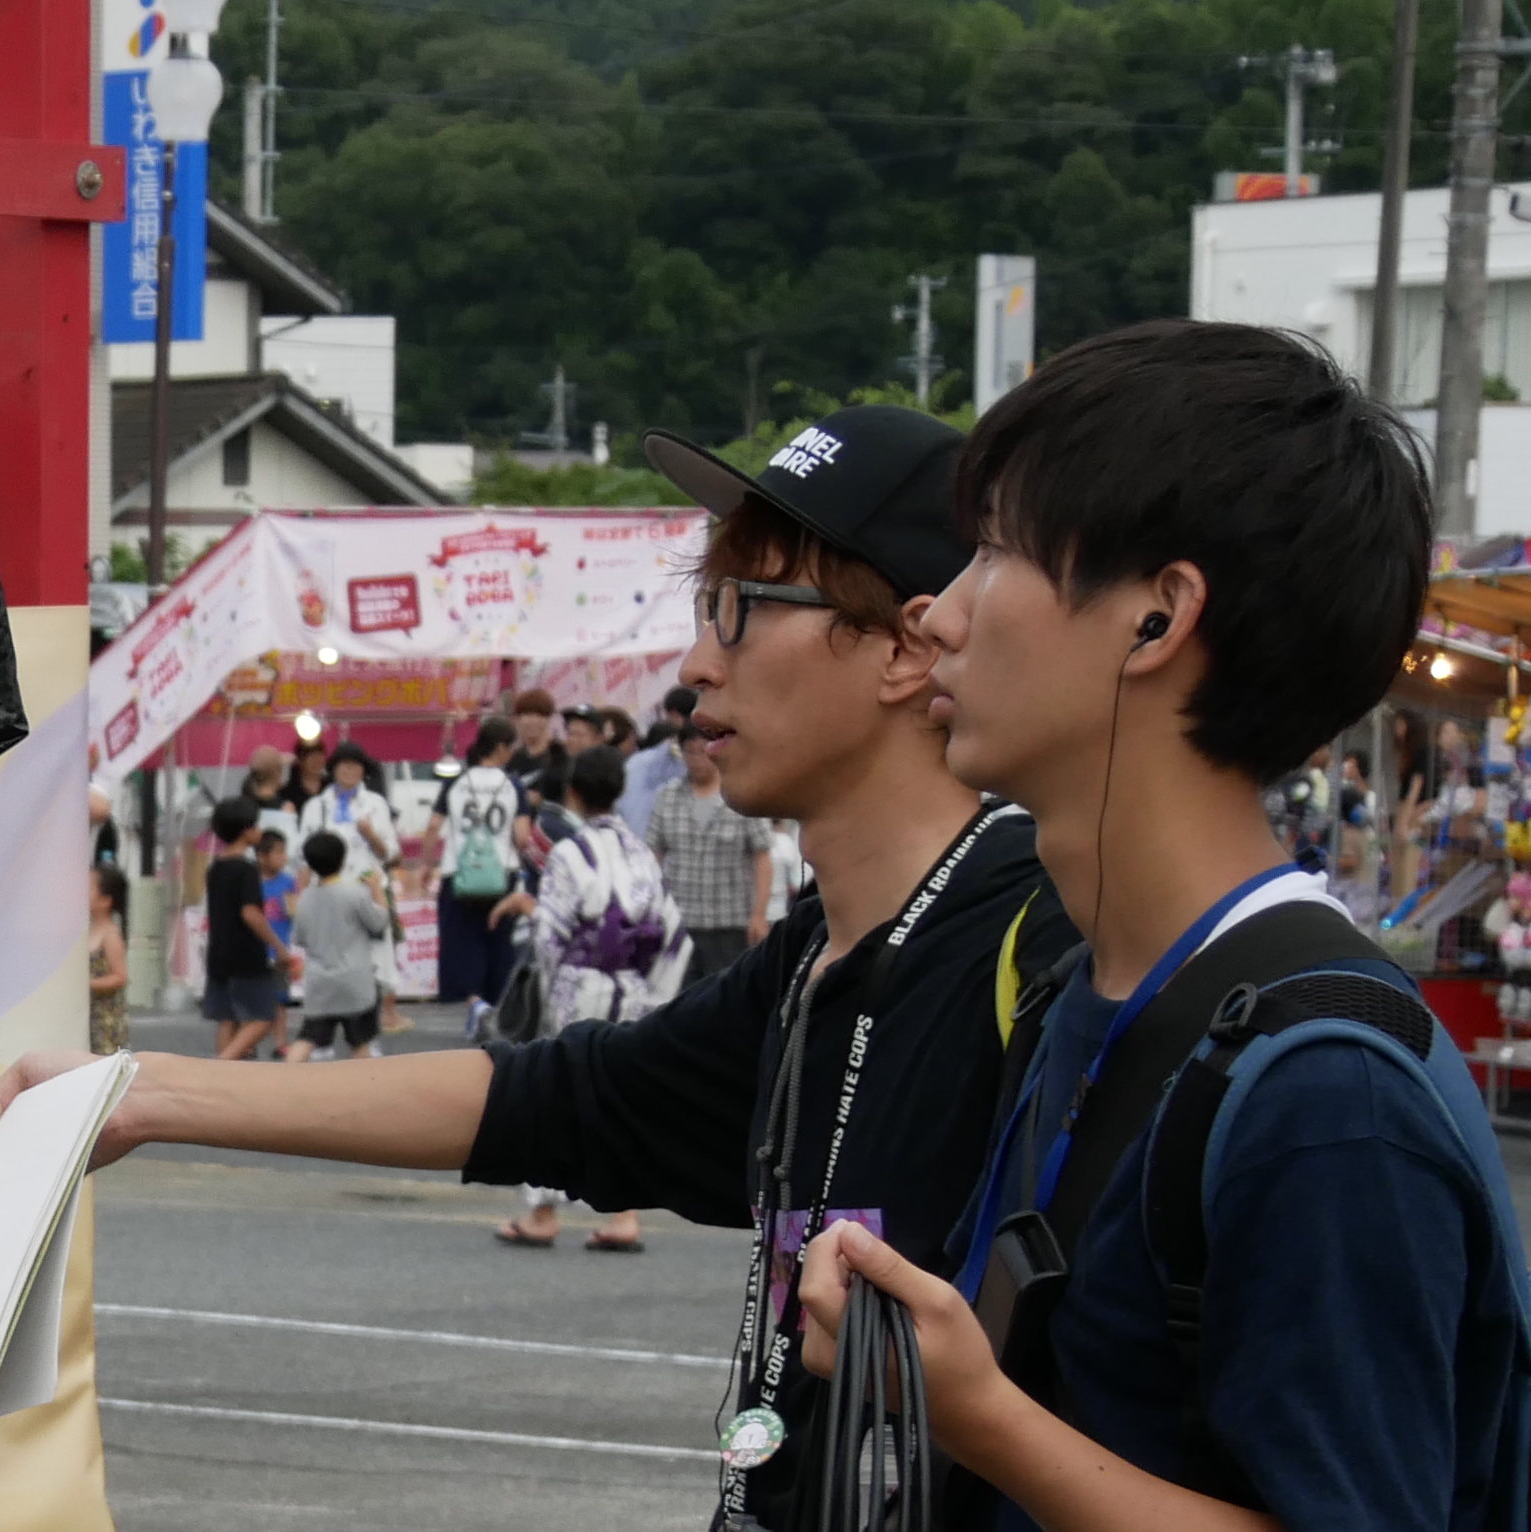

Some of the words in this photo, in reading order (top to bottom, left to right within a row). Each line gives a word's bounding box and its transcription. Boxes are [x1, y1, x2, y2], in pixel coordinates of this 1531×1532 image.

[790, 427, 843, 465] NEL
[887, 889, 938, 947] BLACK
[847, 1013, 875, 1069] COPS
[835, 1068, 861, 1125] HATE
[763, 1332, 791, 1386] COPS
